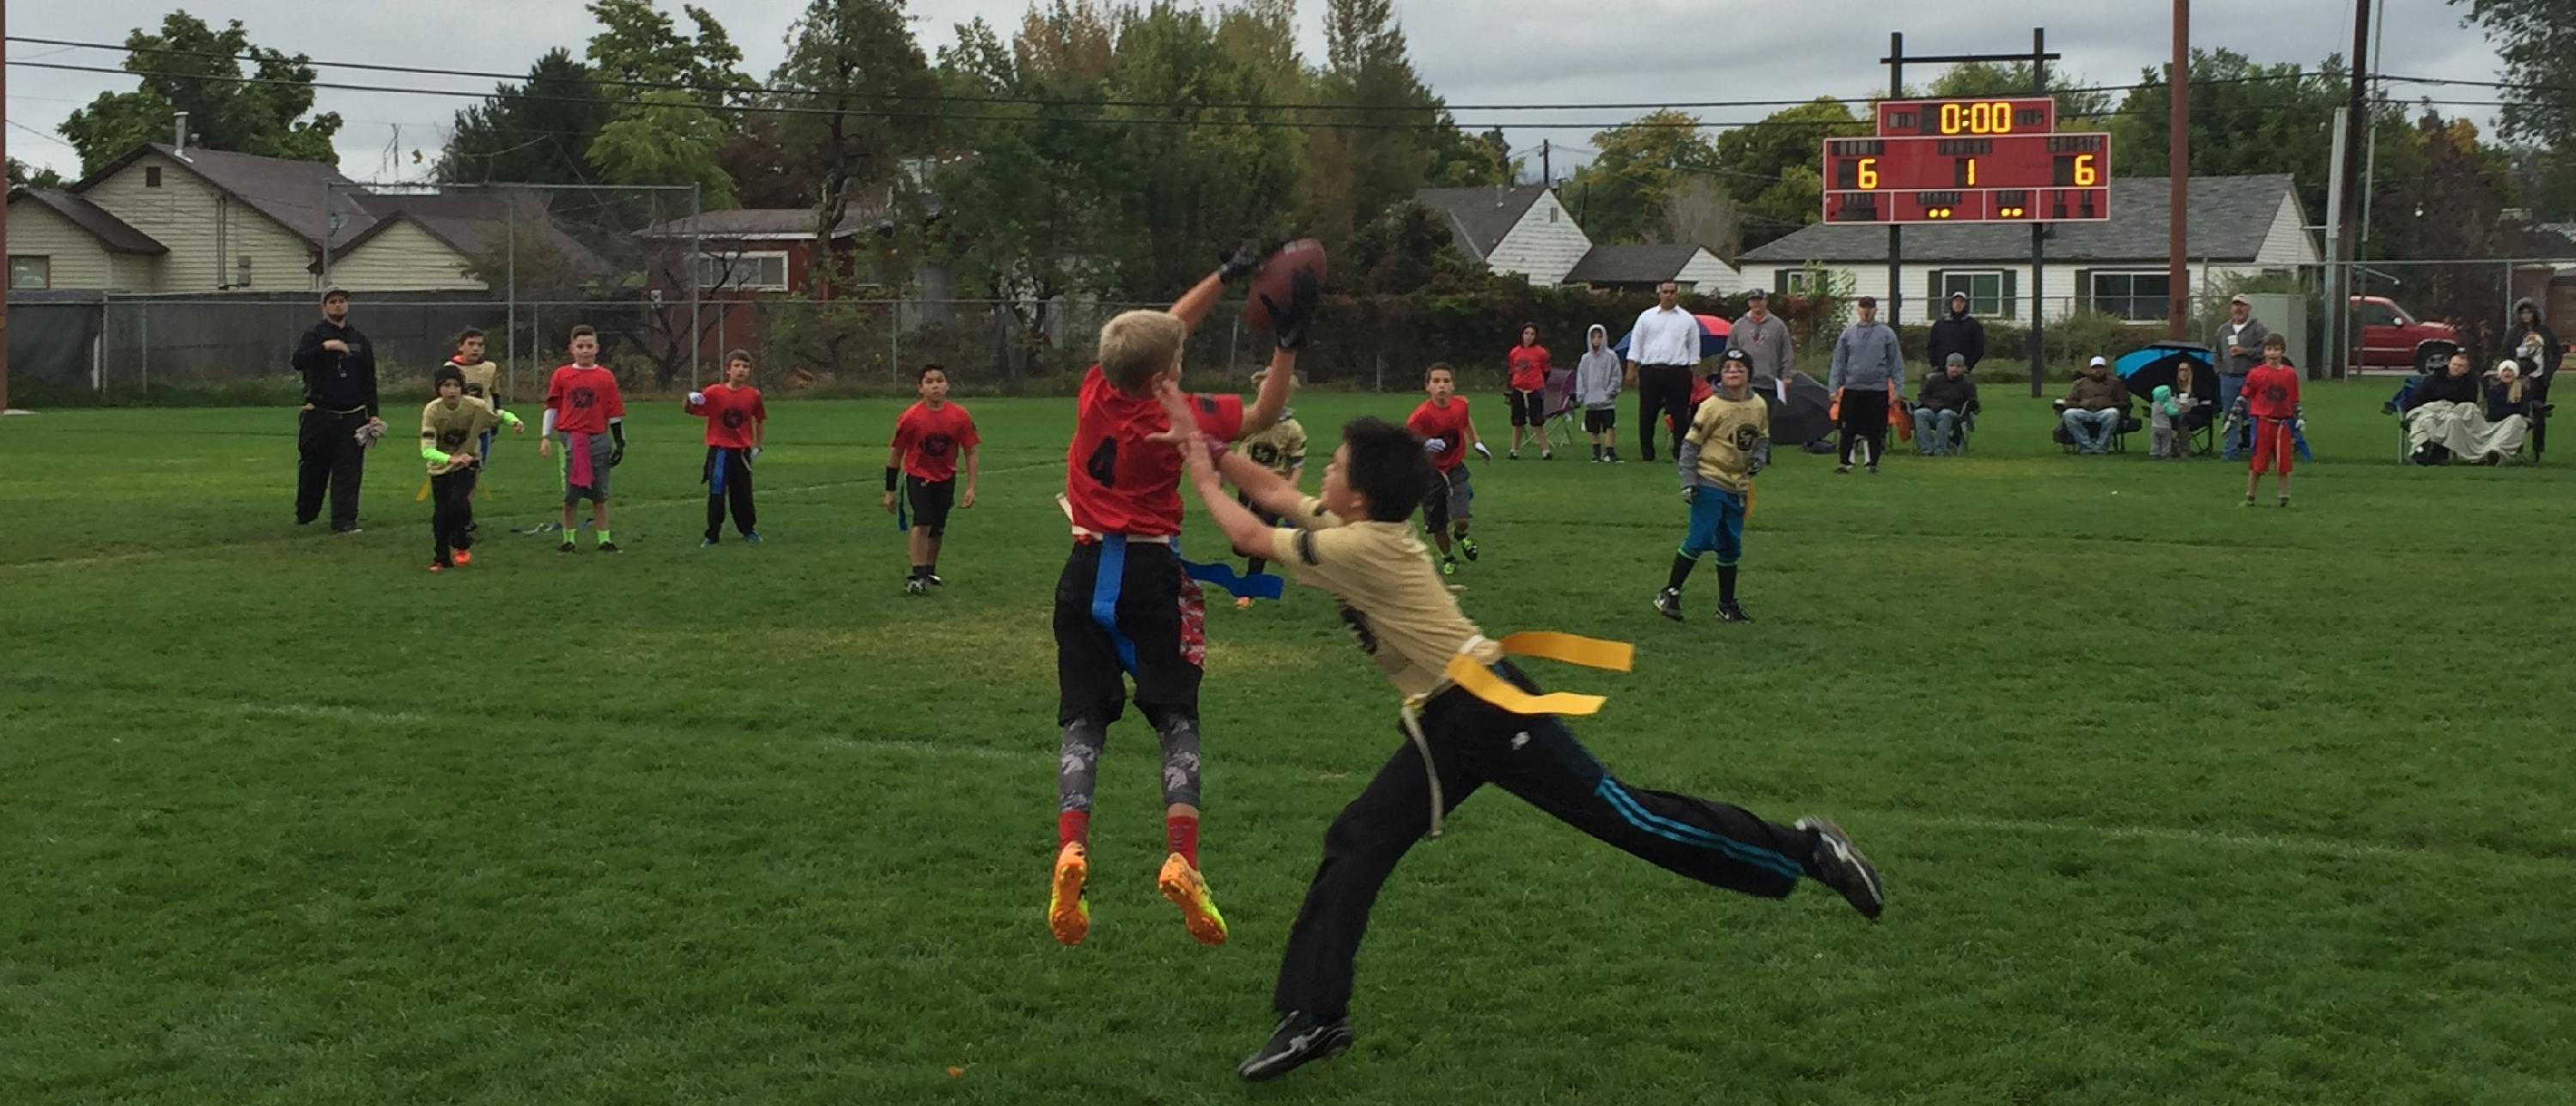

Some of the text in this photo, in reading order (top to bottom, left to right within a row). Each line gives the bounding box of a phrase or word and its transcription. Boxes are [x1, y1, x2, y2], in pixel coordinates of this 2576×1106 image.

[1941, 102, 2011, 134] 0:00
[1857, 158, 1878, 190] 6
[1966, 158, 1976, 185] 1
[2074, 155, 2095, 186] 6
[1088, 435, 1118, 489] 4
